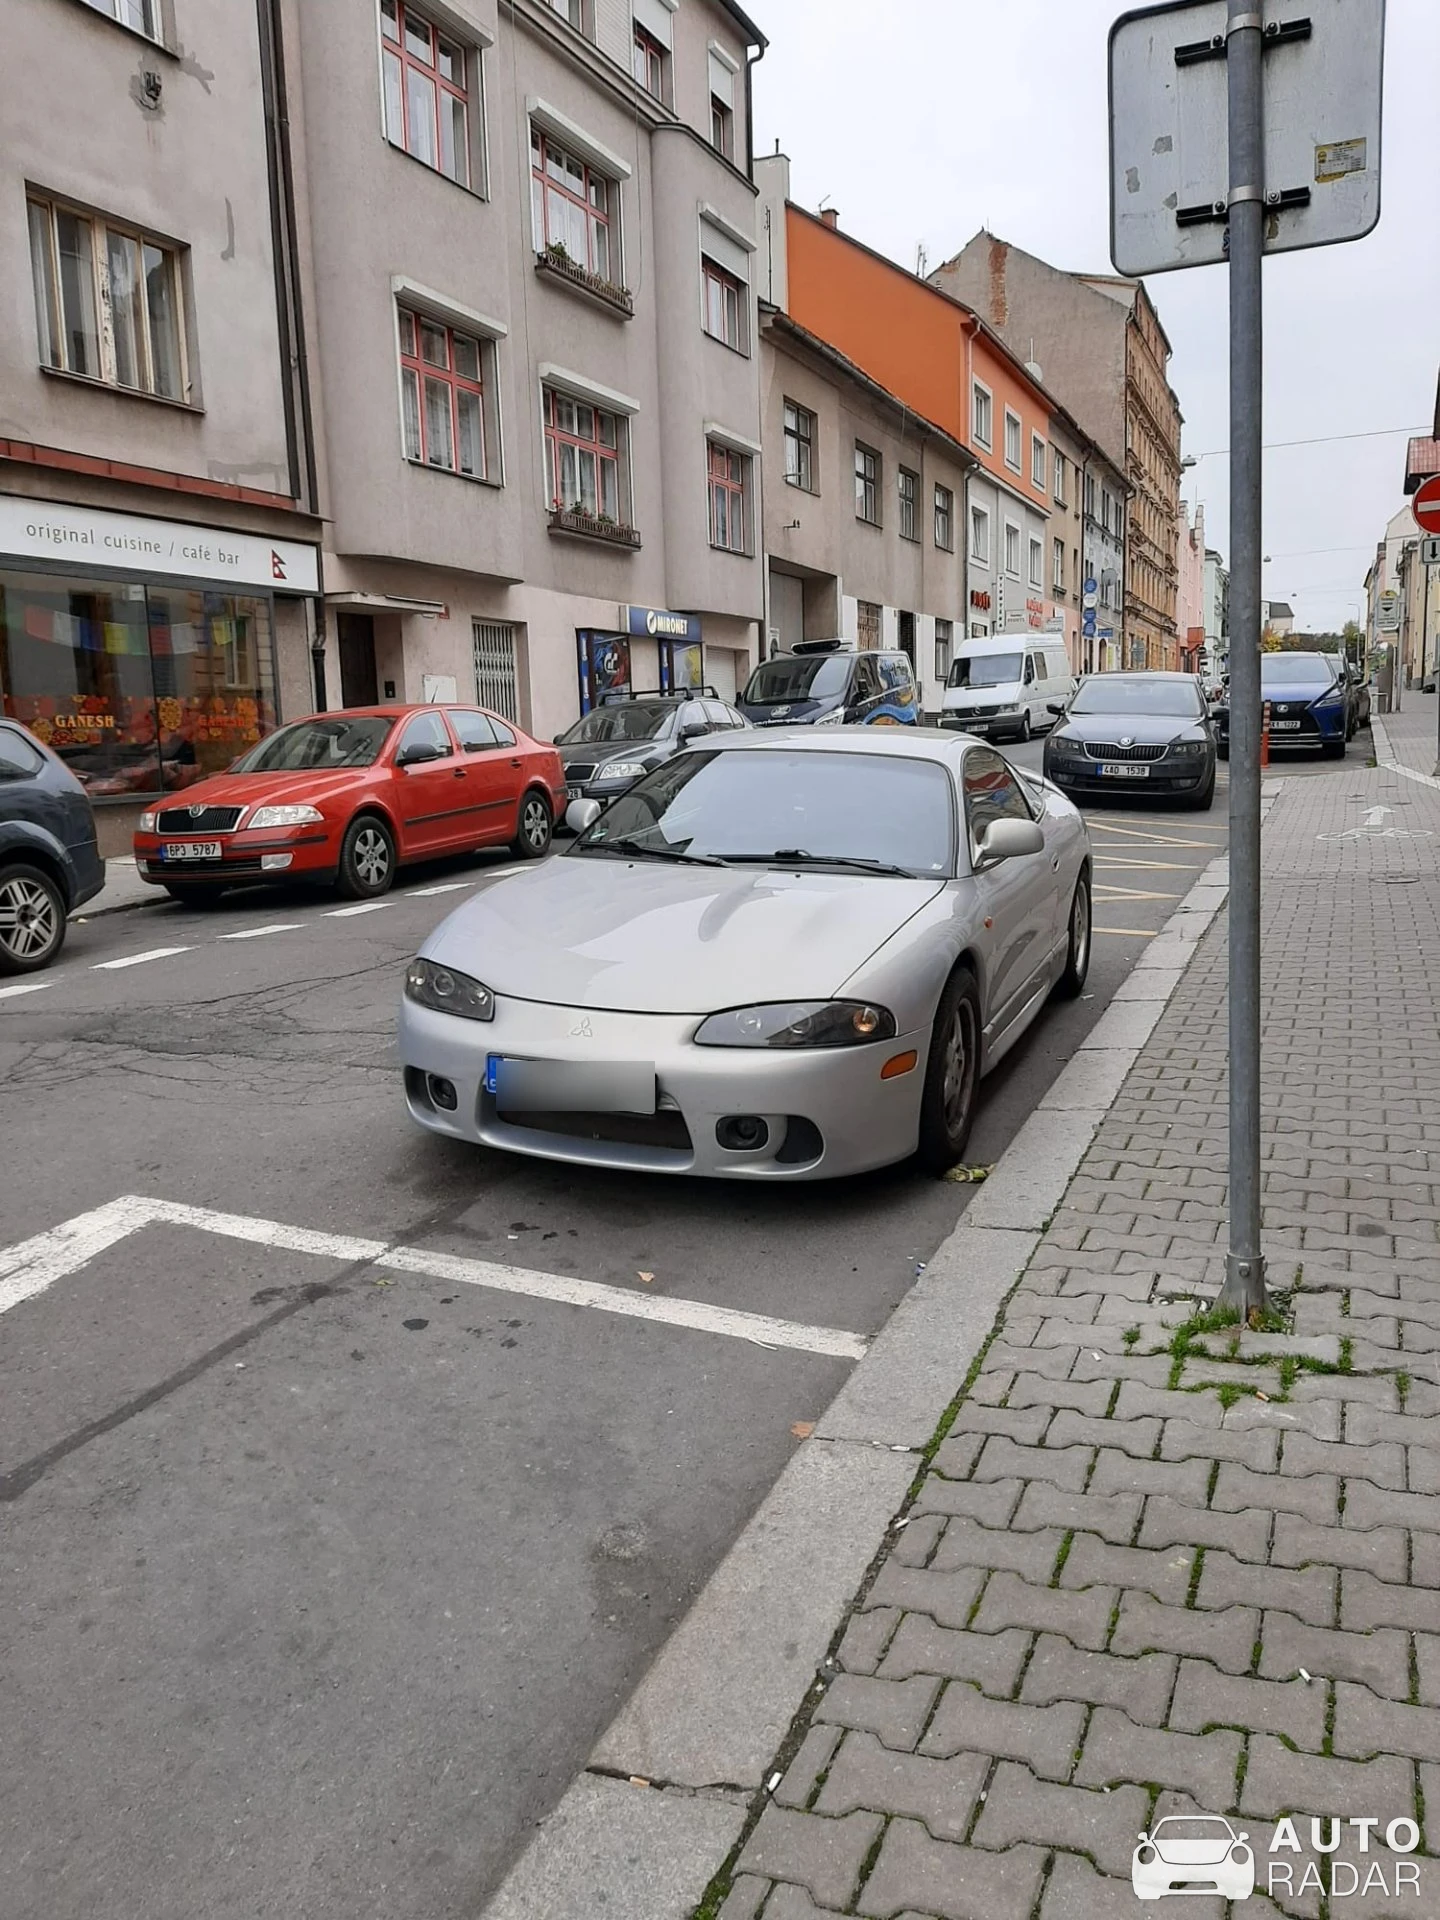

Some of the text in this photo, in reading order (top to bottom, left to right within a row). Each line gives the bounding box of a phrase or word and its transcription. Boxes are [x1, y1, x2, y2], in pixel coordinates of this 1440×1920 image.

[26, 523, 94, 544] original
[104, 534, 161, 554] cuisine
[182, 545, 211, 561] café
[218, 548, 240, 565] bar
[657, 615, 688, 635] MIRONET
[54, 714, 115, 728] GANESH
[169, 843, 217, 857] 6P3 5787
